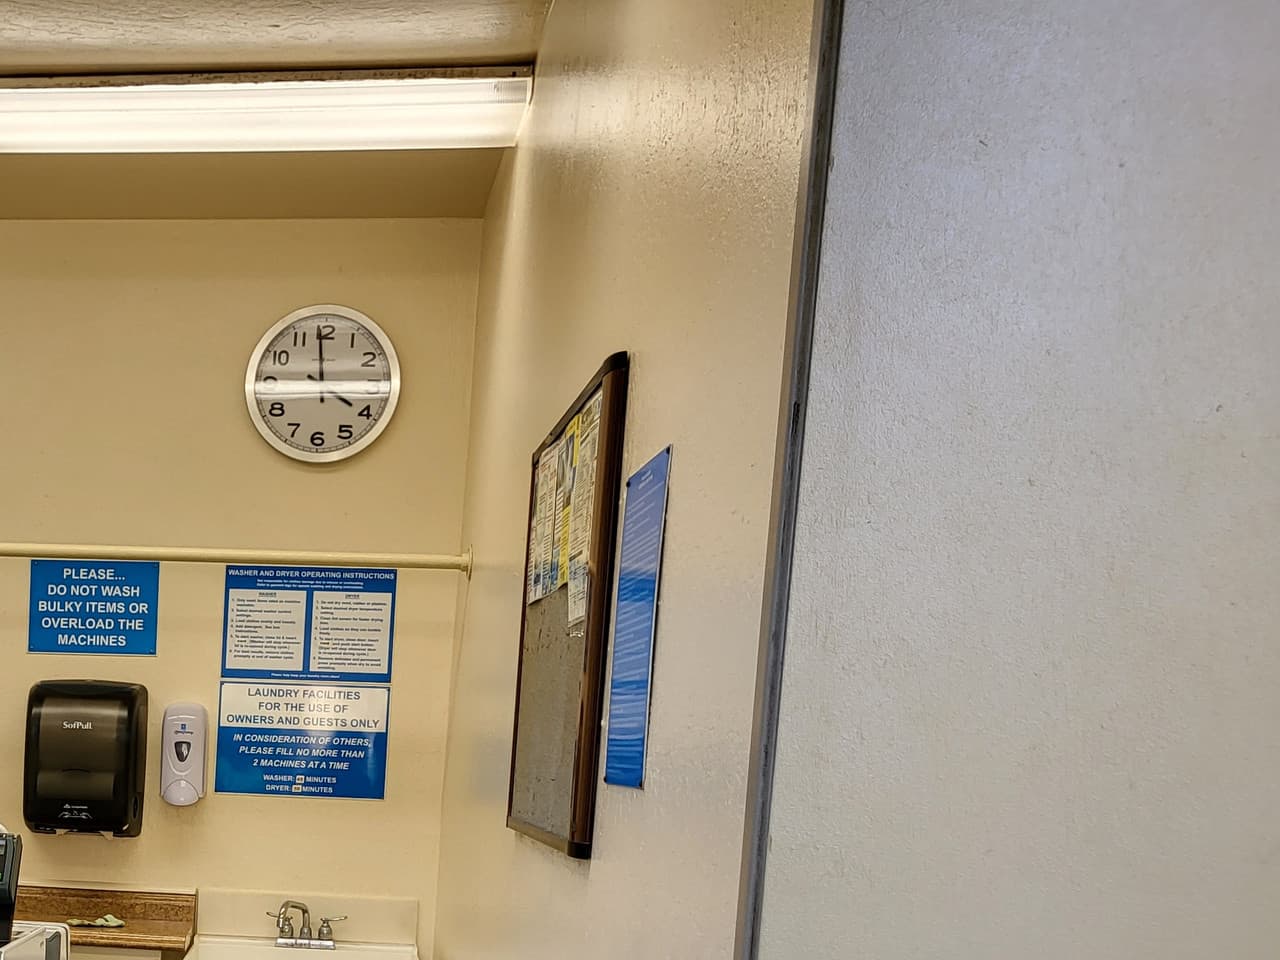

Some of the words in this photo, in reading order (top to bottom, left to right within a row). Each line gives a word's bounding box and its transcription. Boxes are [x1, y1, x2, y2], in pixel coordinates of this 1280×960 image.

[293, 332, 306, 347] 11
[350, 332, 355, 348] 1
[272, 350, 289, 365] 10
[361, 352, 376, 367] 2
[269, 402, 285, 417] 8
[358, 405, 372, 420] 4
[288, 423, 300, 437] 7
[337, 425, 353, 439] 5
[310, 432, 324, 446] 6
[343, 572, 394, 580] INSTRUCTIONS
[48, 585, 67, 596] DO
[70, 586, 99, 597] NOT
[101, 586, 140, 597] WASH
[39, 601, 82, 613] BULKY
[86, 602, 125, 614] ITEMS
[129, 603, 148, 614] OR
[42, 617, 115, 630] OVERLOAD
[118, 619, 144, 630] THE
[58, 634, 126, 646] MACHINES
[248, 688, 299, 698] LAUNDRY
[303, 689, 360, 700] FACILITIES
[258, 702, 280, 711] FOR
[284, 703, 305, 712] THE
[308, 704, 330, 712] USE
[333, 705, 349, 713] OF
[63, 721, 92, 730] SofPull
[227, 715, 274, 724] OWNERS
[278, 717, 300, 725] AND
[303, 718, 347, 727] GUESTS
[351, 719, 380, 728] ONLY
[244, 734, 316, 744] CONSIDERATION
[239, 746, 273, 755] PLEASE
[296, 748, 309, 756] NO
[312, 749, 338, 757] MORE
[340, 750, 365, 758] THAN
[260, 759, 306, 768] MACHINES
[308, 761, 319, 769] AT
[328, 762, 349, 770] TIME
